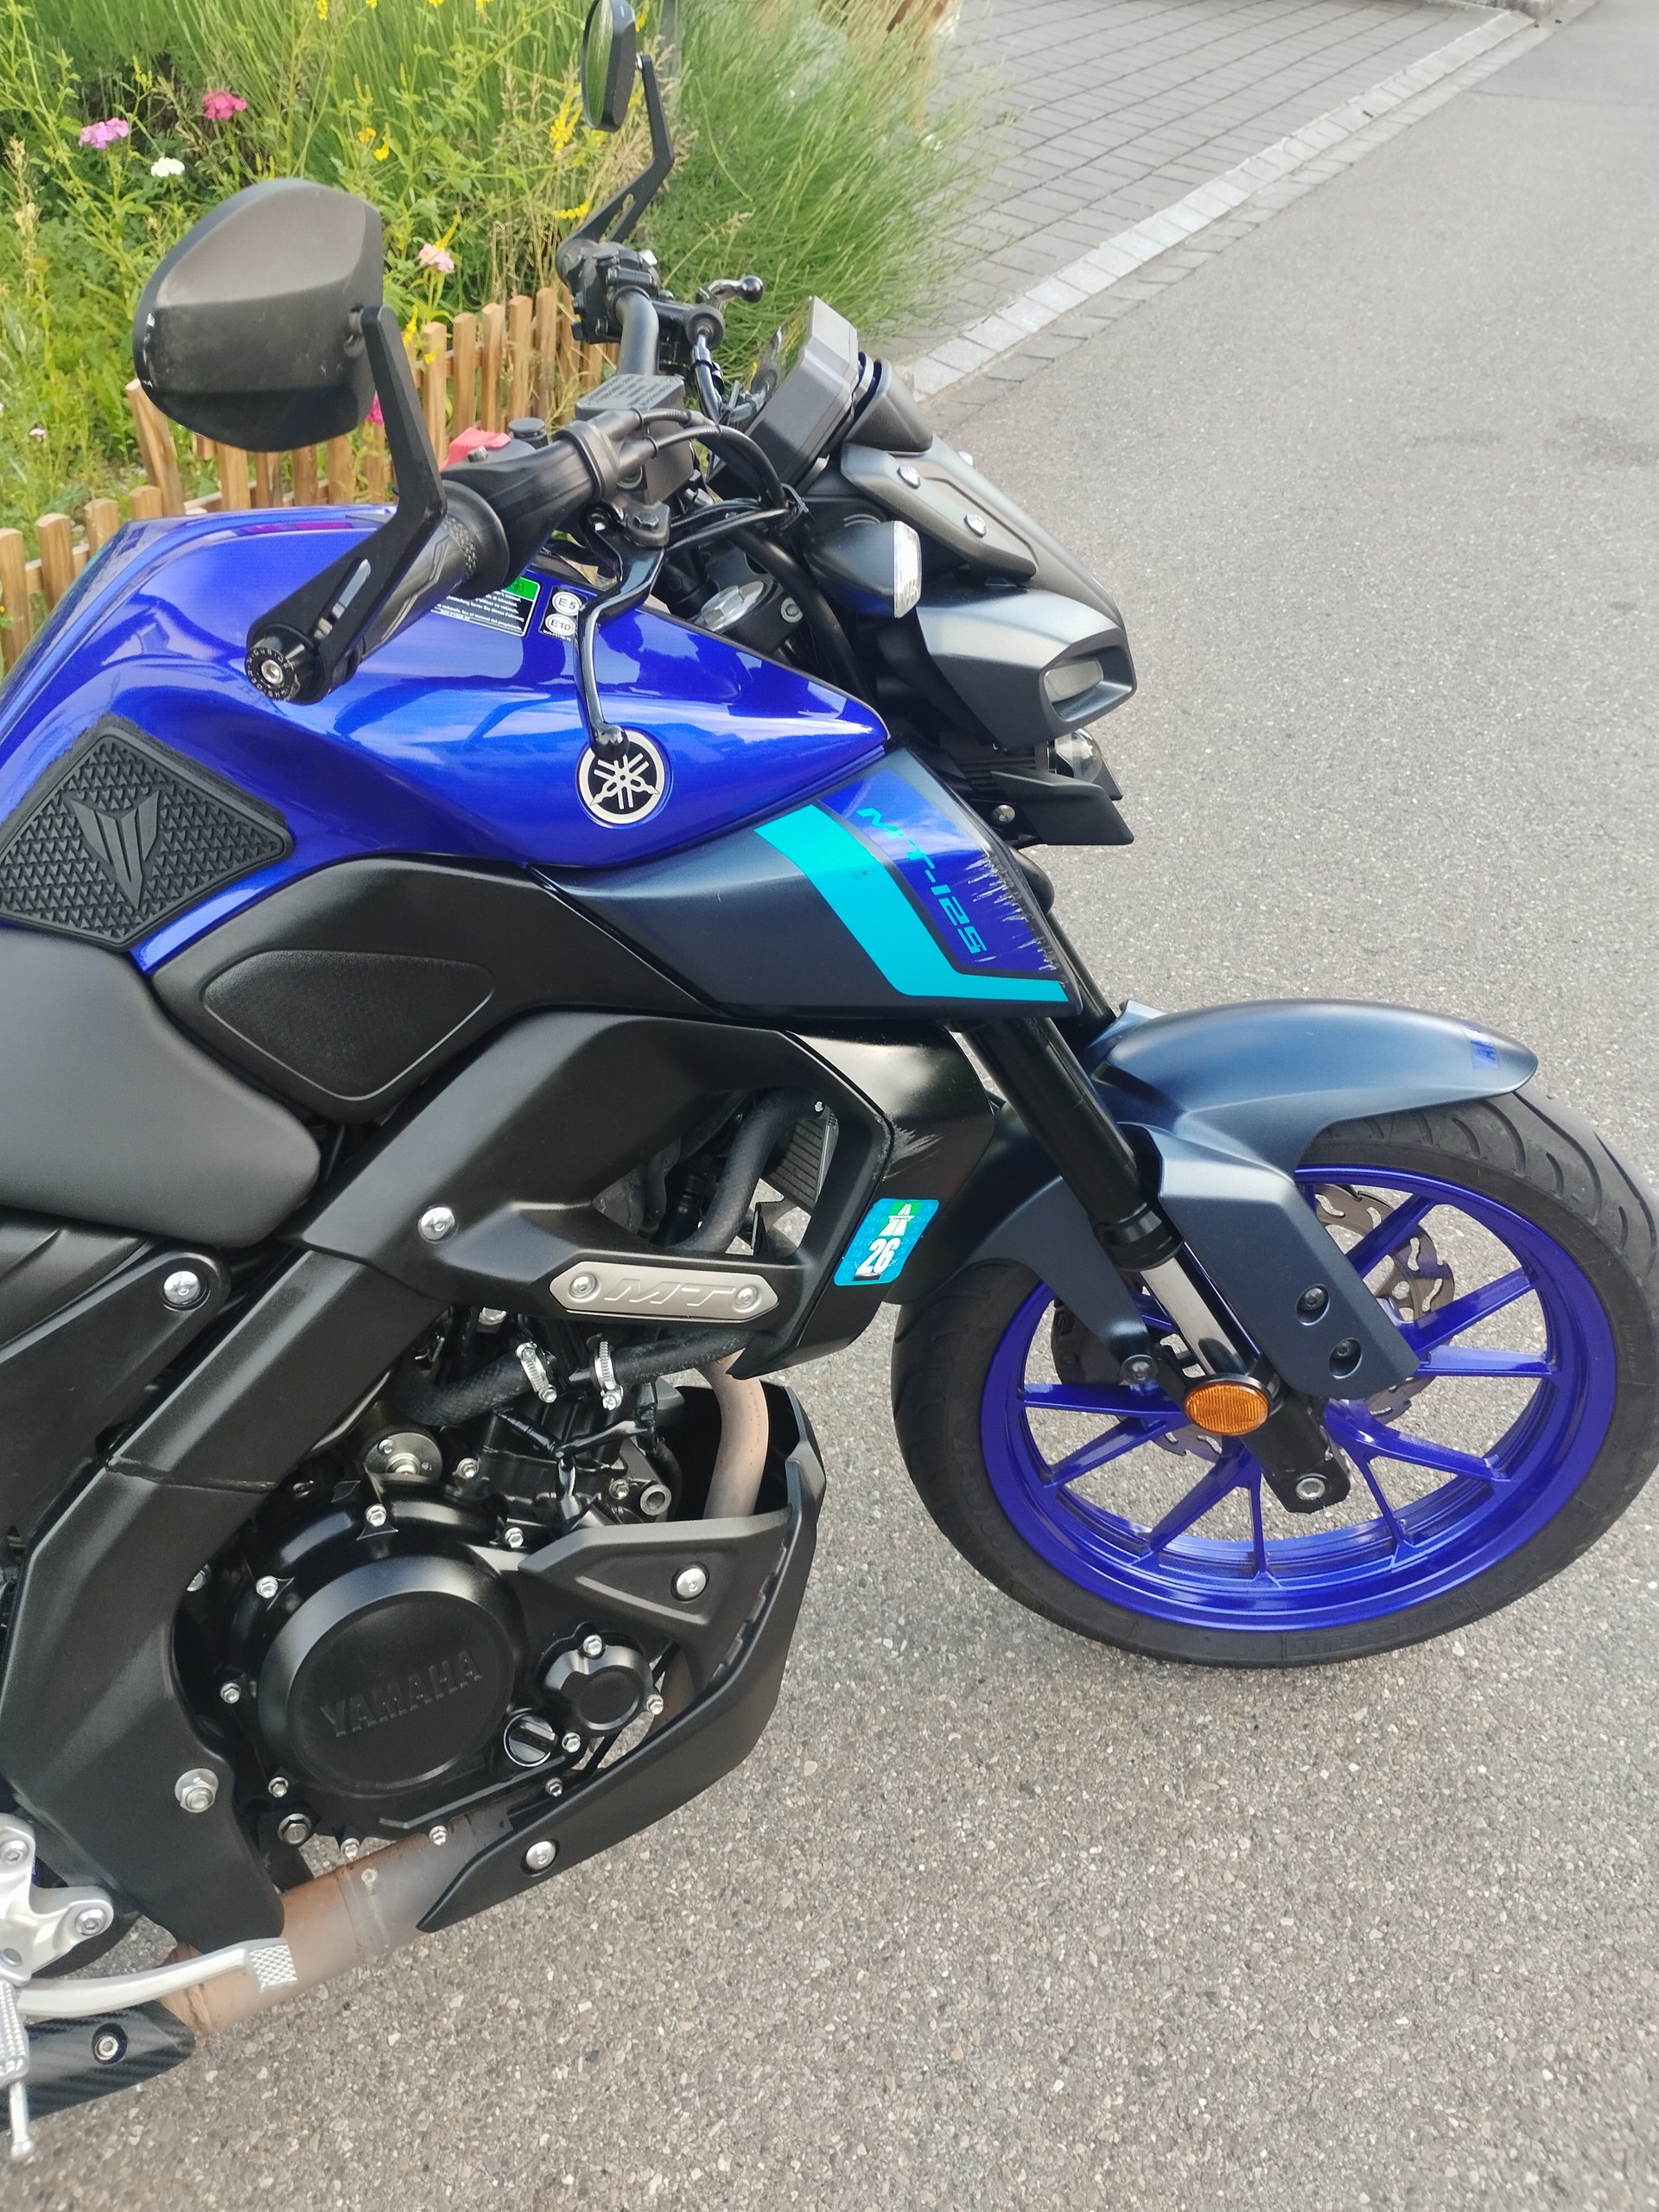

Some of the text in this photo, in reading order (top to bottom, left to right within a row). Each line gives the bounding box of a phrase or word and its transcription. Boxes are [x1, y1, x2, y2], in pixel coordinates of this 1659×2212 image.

[550, 619, 571, 632] E10
[856, 807, 987, 954] MT-125
[855, 1237, 901, 1274] 26
[604, 1278, 736, 1307] MT
[319, 1649, 483, 1738] YAMAHA
